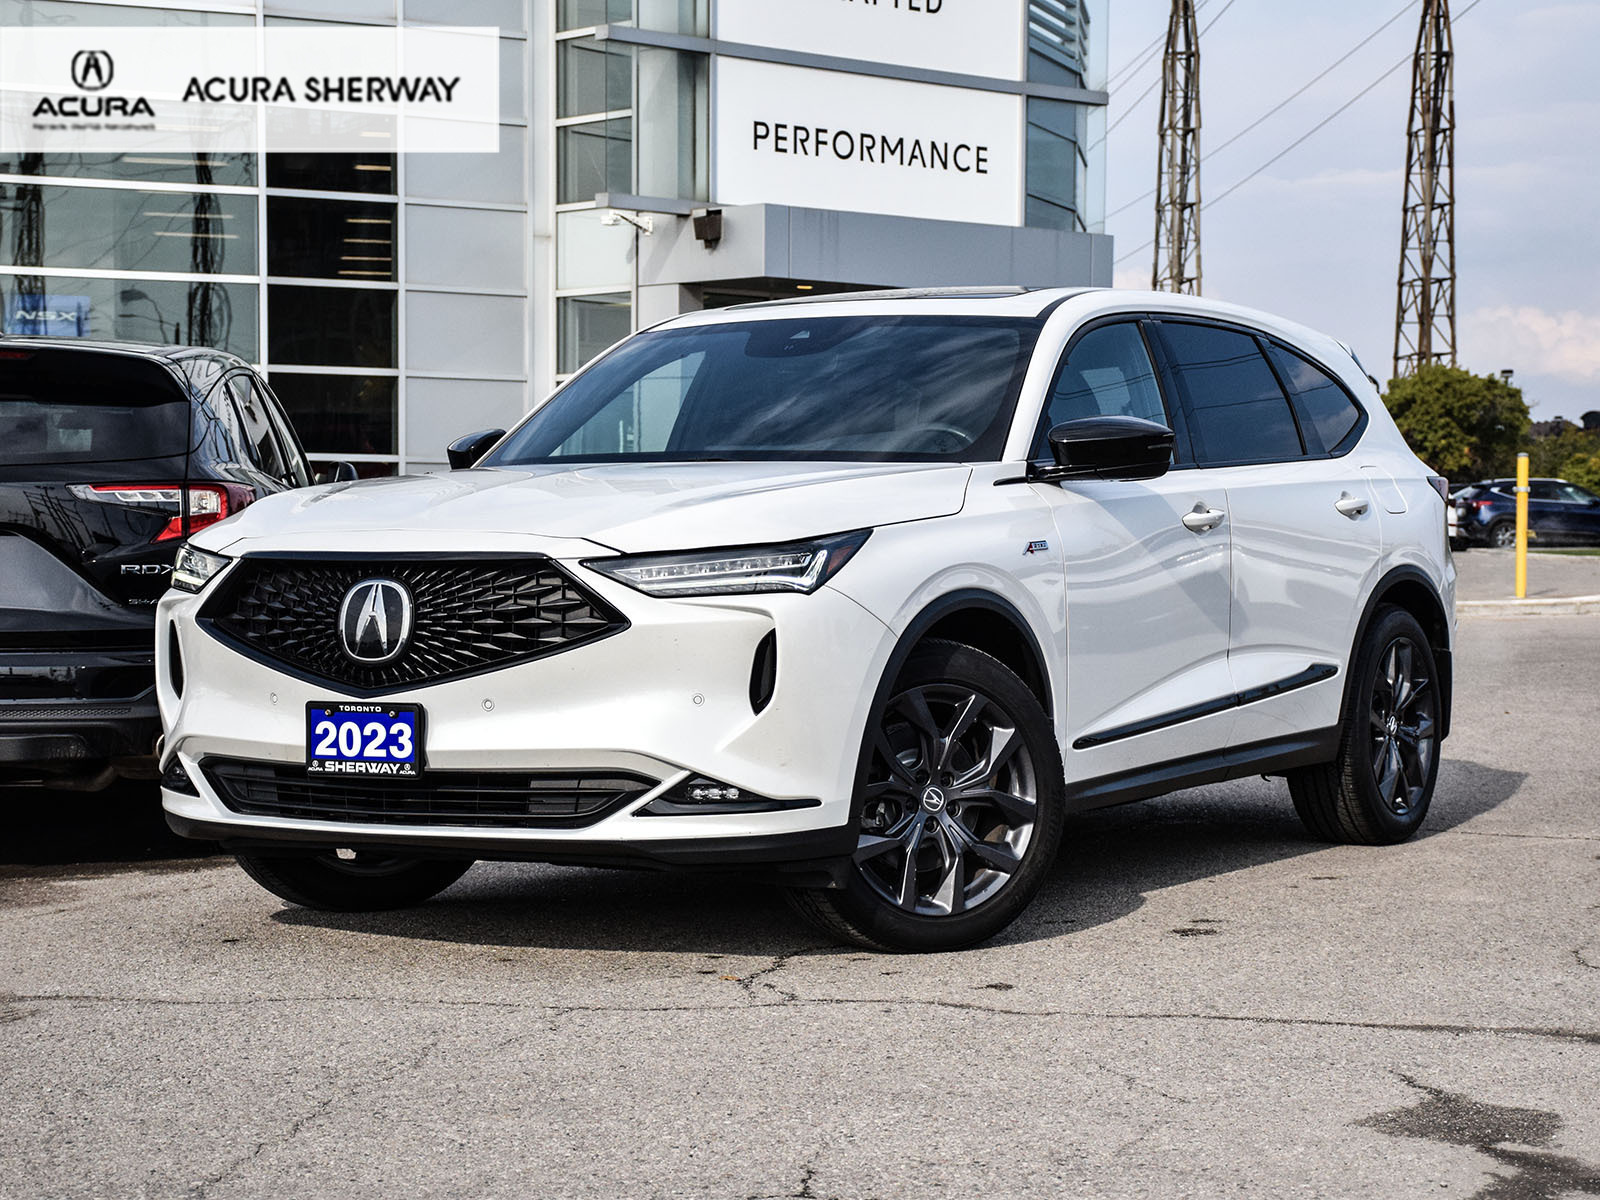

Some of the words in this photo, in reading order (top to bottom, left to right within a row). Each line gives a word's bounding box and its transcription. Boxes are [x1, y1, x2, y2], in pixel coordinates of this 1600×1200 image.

[753, 120, 988, 174] PERFORMANCE
[15, 310, 77, 321] NSX
[314, 720, 413, 759] 2023
[324, 761, 400, 774] SHERWAY
